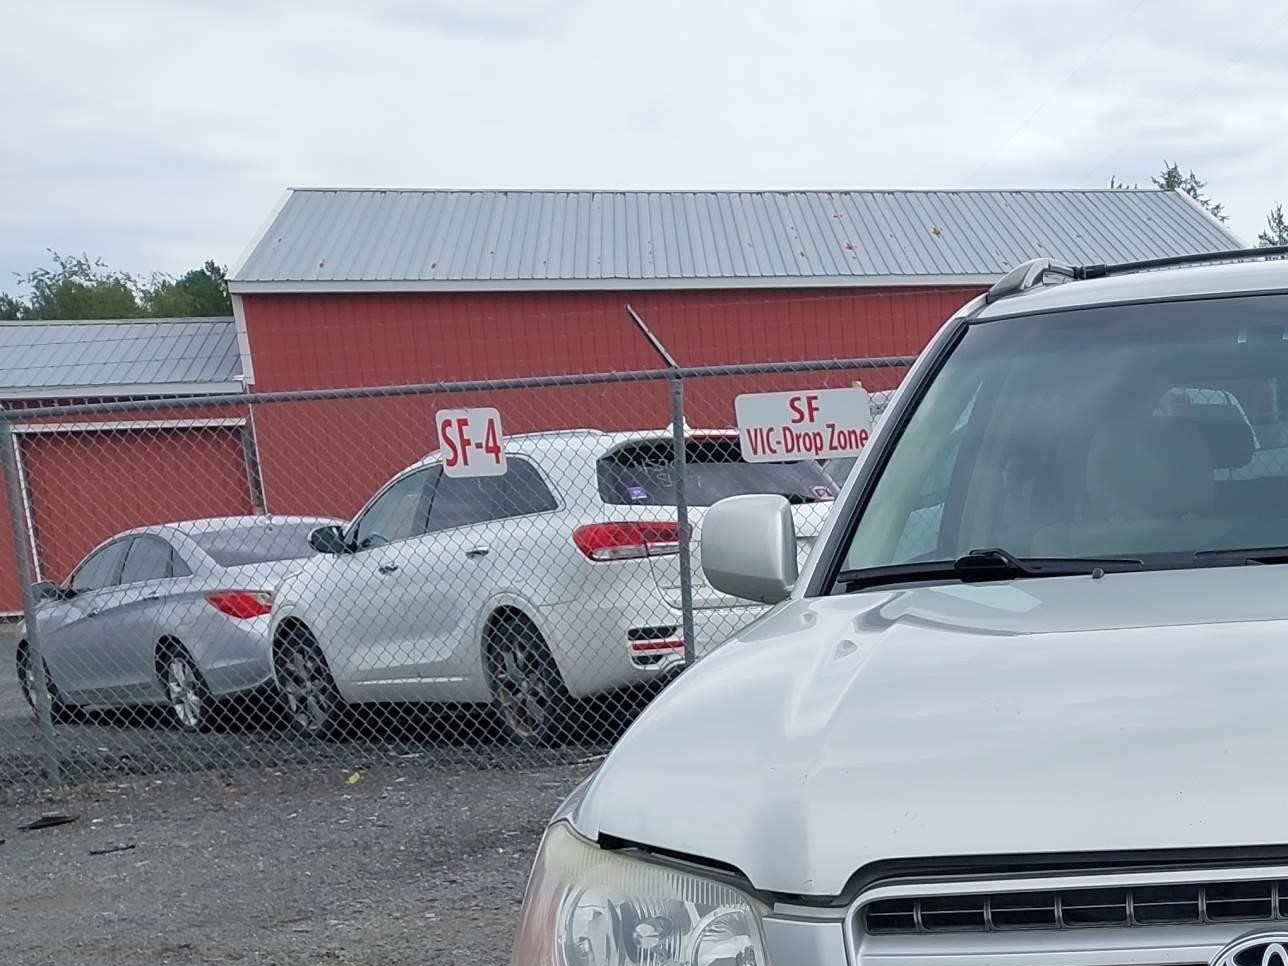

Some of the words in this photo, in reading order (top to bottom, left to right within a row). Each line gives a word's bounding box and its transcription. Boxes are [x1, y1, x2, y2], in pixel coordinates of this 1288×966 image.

[788, 395, 820, 424] SF
[441, 418, 502, 467] SF-4
[746, 426, 824, 456] VIC-Drop
[826, 423, 869, 451] Zone
